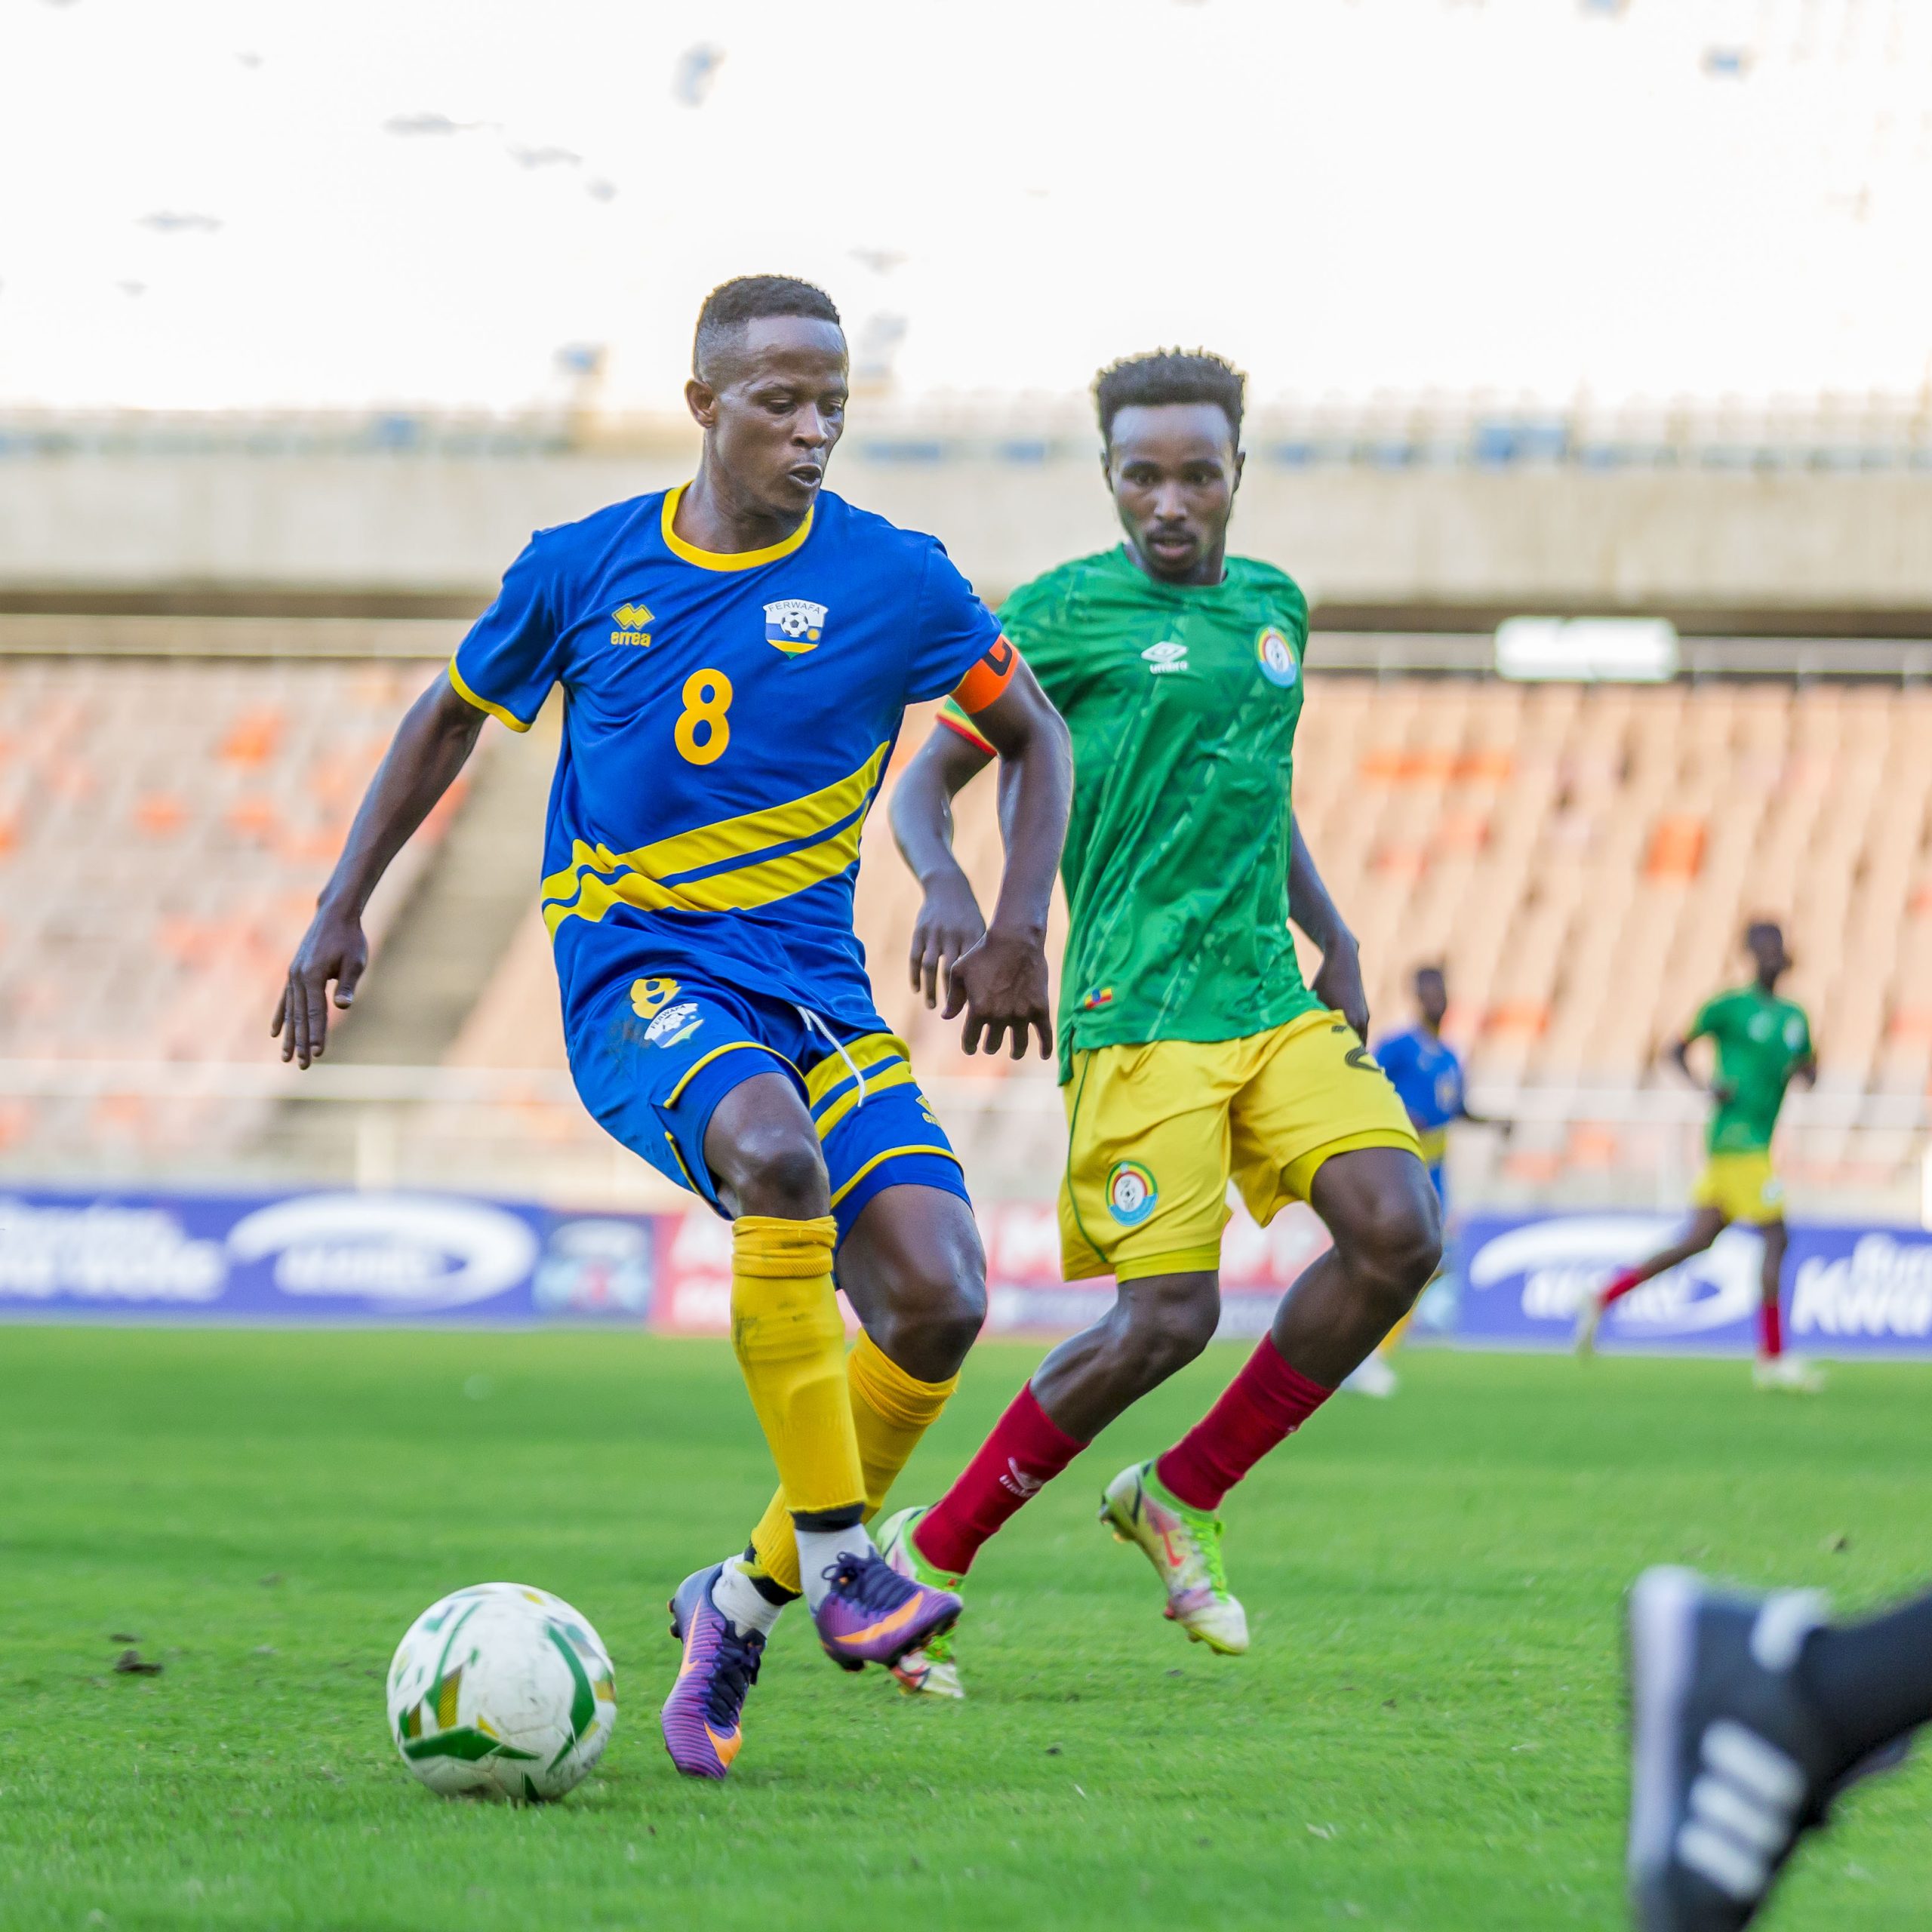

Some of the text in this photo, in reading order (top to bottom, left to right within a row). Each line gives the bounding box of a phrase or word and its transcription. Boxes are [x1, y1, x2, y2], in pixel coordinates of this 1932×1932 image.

[768, 601, 820, 614] FERWAFA
[611, 631, 651, 648] errea
[674, 668, 733, 765] 8
[630, 978, 681, 1020] 8
